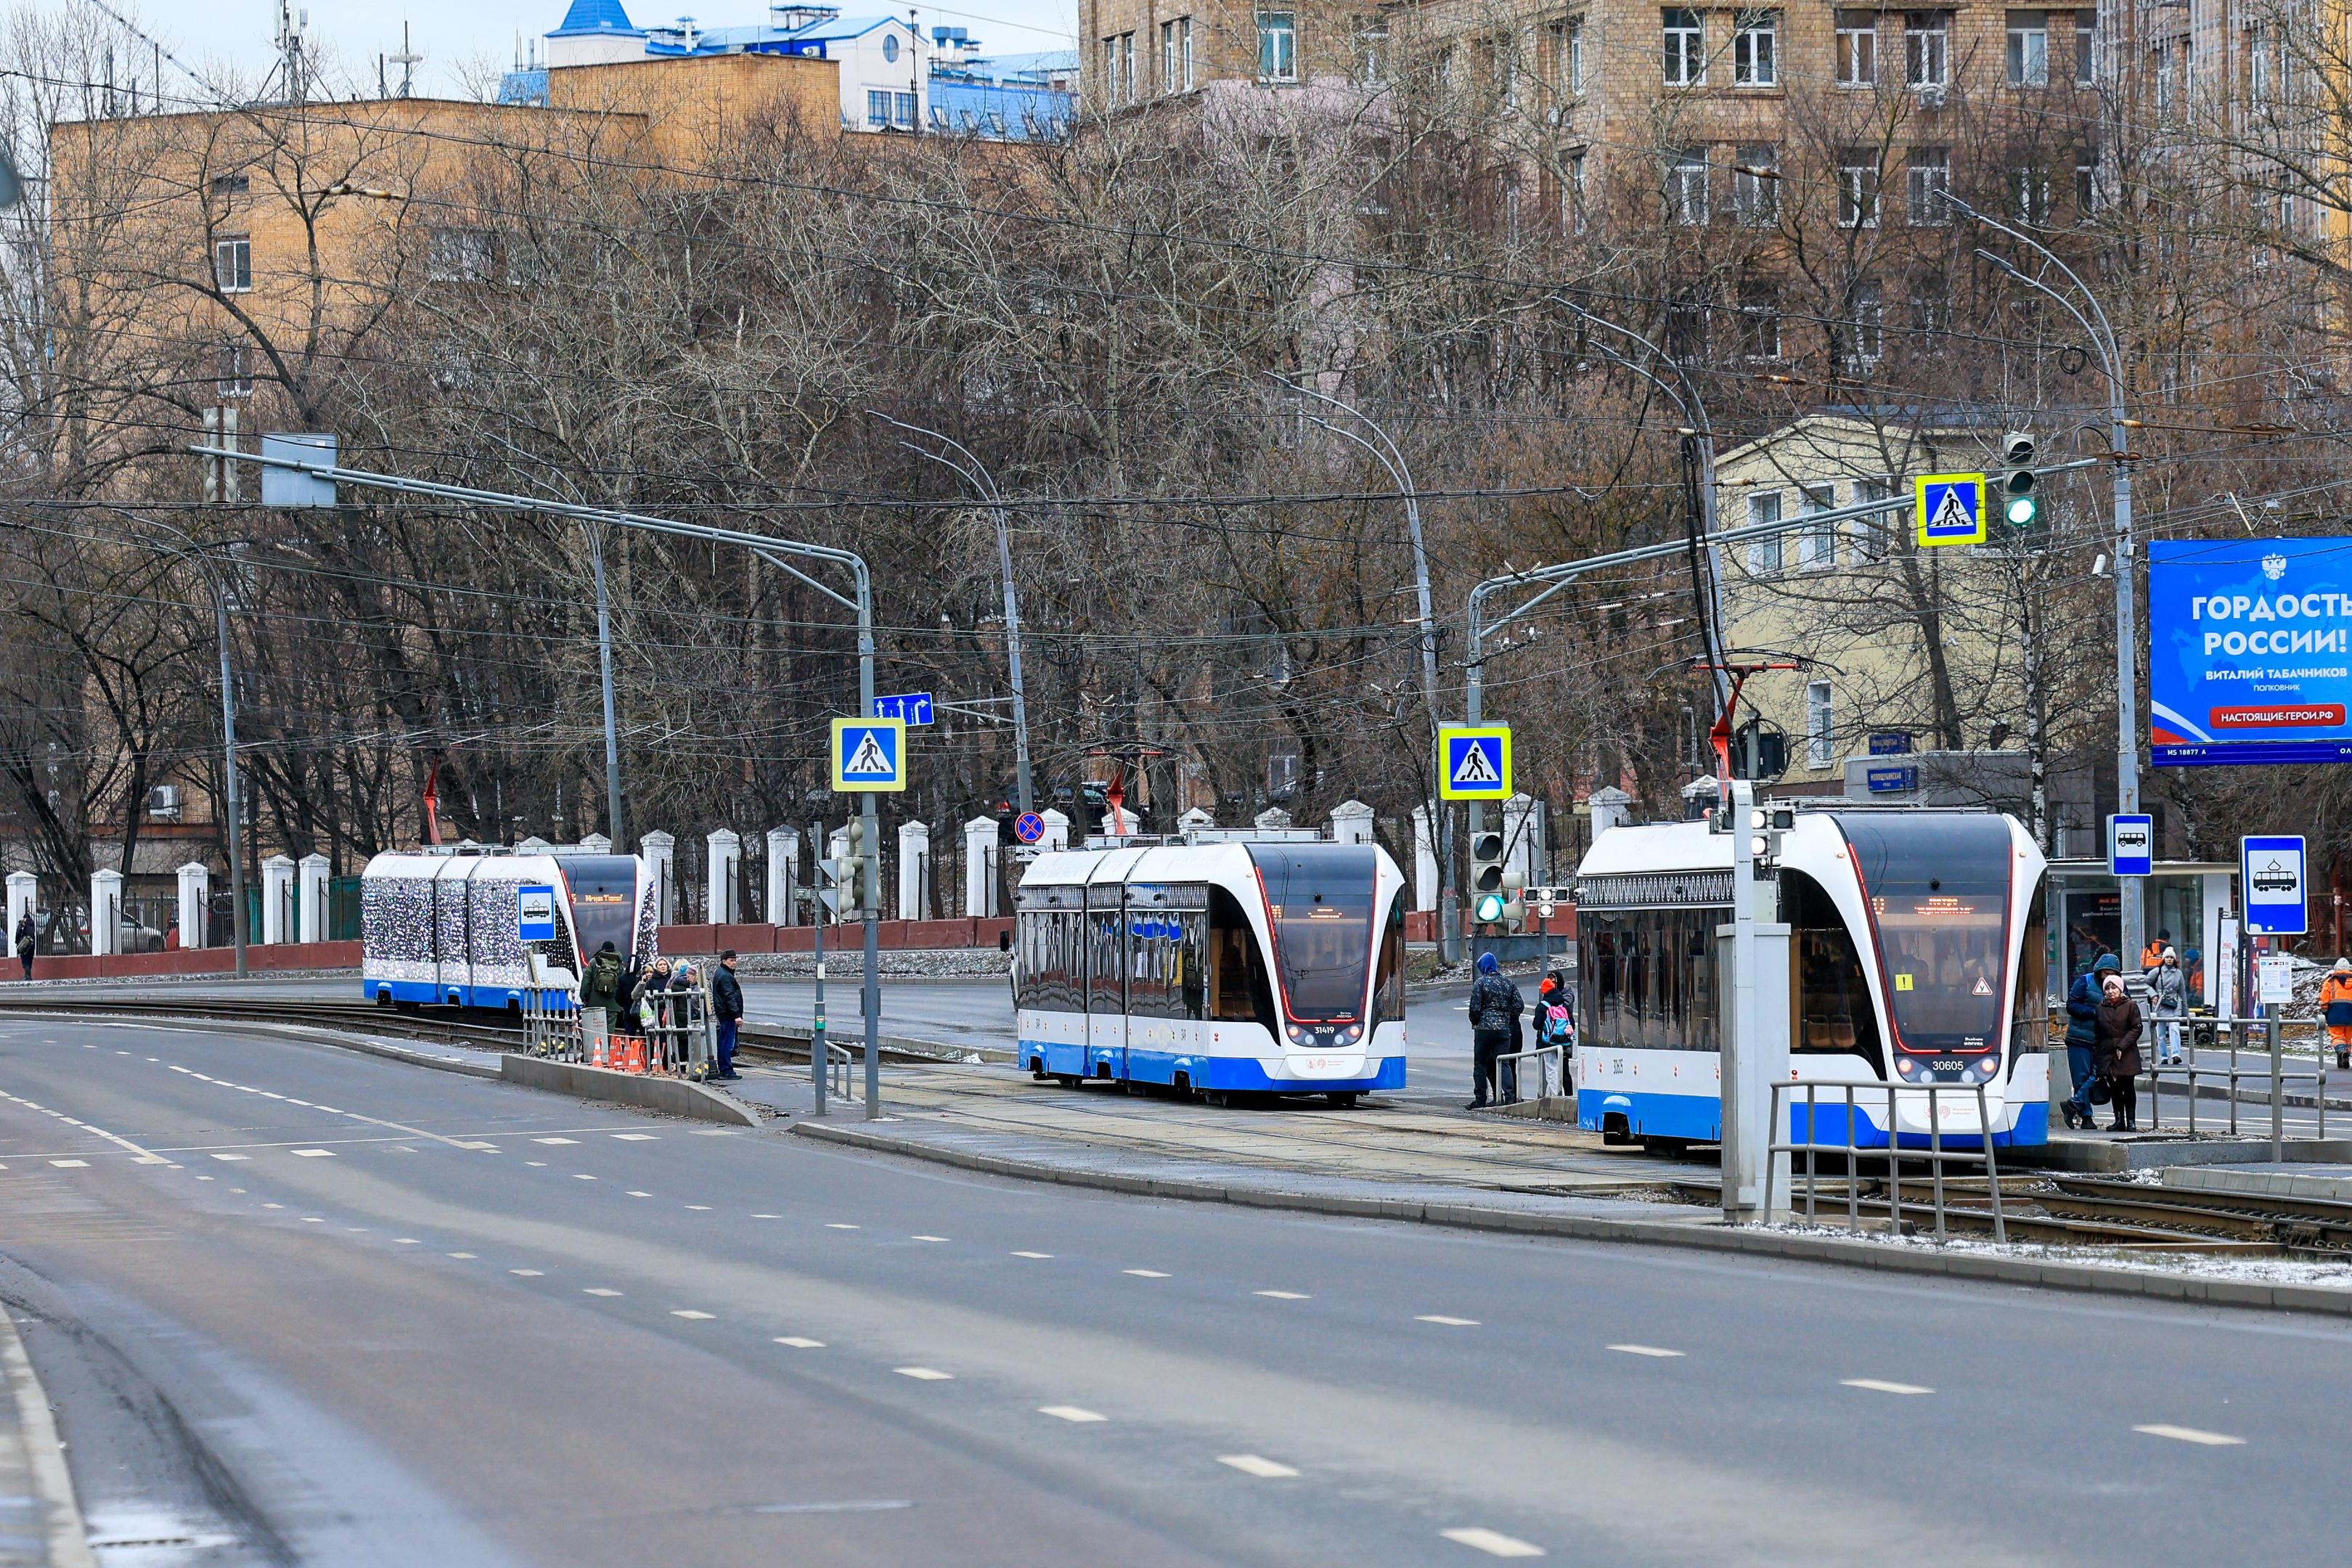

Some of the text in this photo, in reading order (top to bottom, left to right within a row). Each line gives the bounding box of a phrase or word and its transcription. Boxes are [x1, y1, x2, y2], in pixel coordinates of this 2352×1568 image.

[2192, 594, 2352, 621] ГОРДОСТЬ
[2205, 629, 2346, 656] РОССИИ!
[2205, 667, 2348, 680] ВИТАЛИЙ ТАБАЧНИКОВ
[2221, 711, 2333, 722] НАСТОЯЩИЕ-ГЕРОИ.РФ
[1932, 1061, 1964, 1071] 30605
